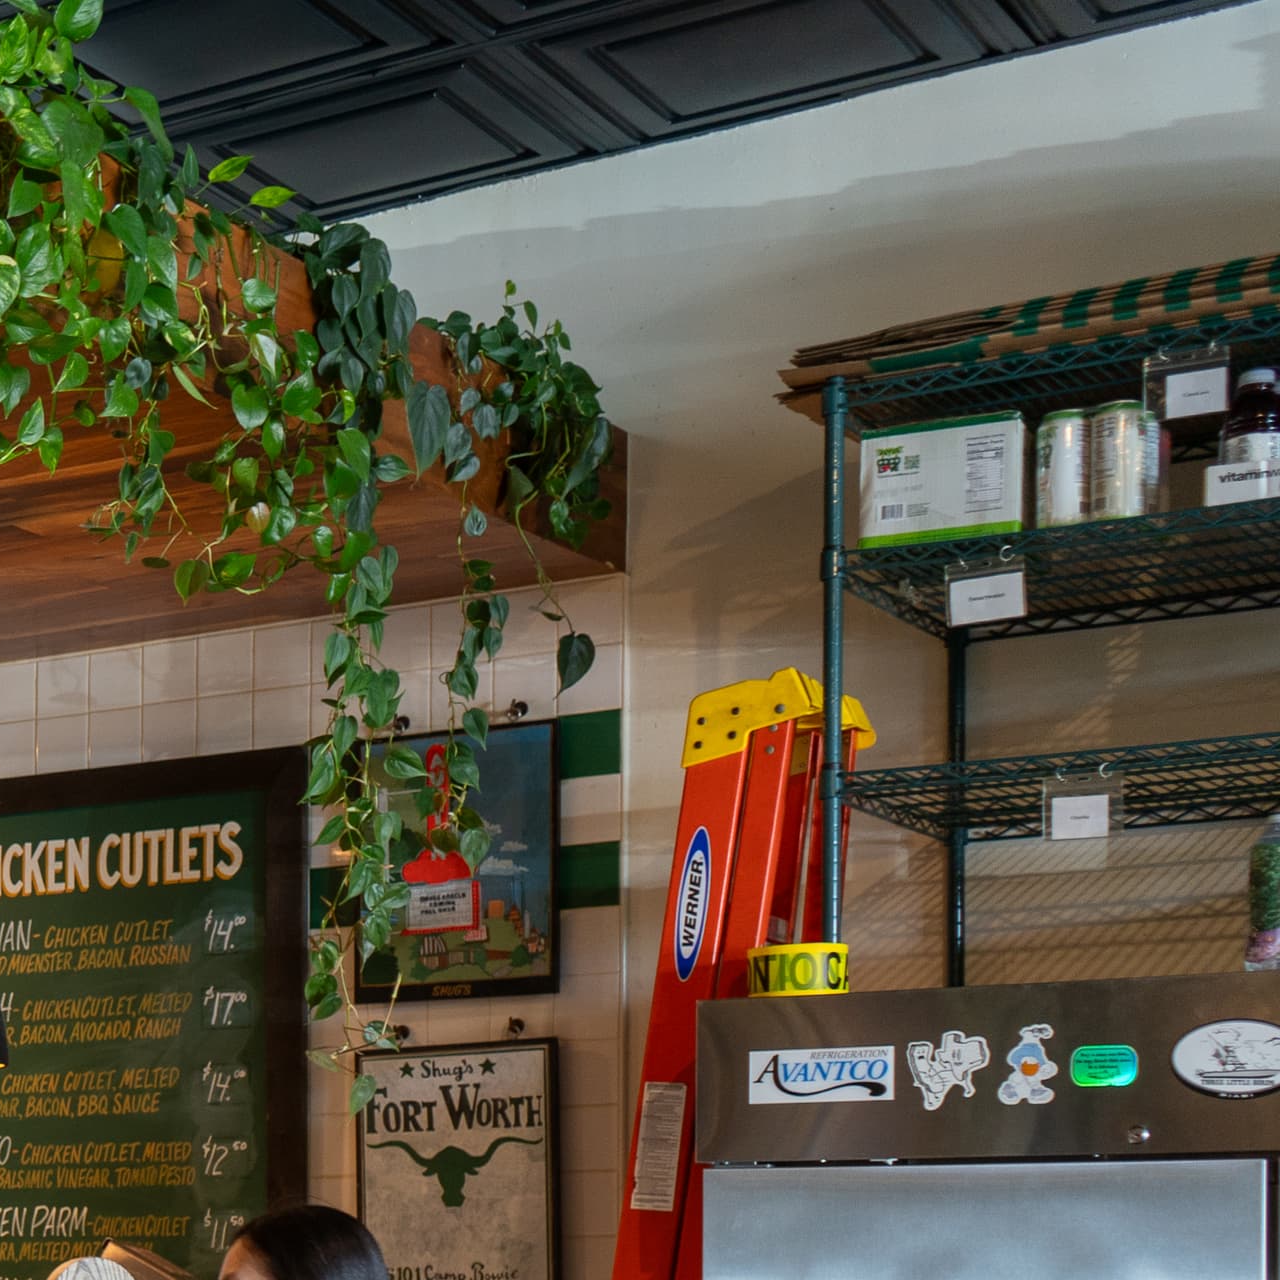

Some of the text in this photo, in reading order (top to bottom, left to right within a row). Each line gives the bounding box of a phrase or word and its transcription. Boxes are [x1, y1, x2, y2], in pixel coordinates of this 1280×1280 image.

[96, 820, 244, 888] CUTLETS
[682, 860, 704, 947] WERNER
[432, 984, 471, 996] SHUG'S
[754, 1054, 889, 1085] AVANTCO
[810, 1049, 888, 1060] REFRIGERATION
[421, 1059, 474, 1082] Shug's
[366, 1083, 543, 1134] FORT WORTH
[31, 1205, 88, 1237] PARM
